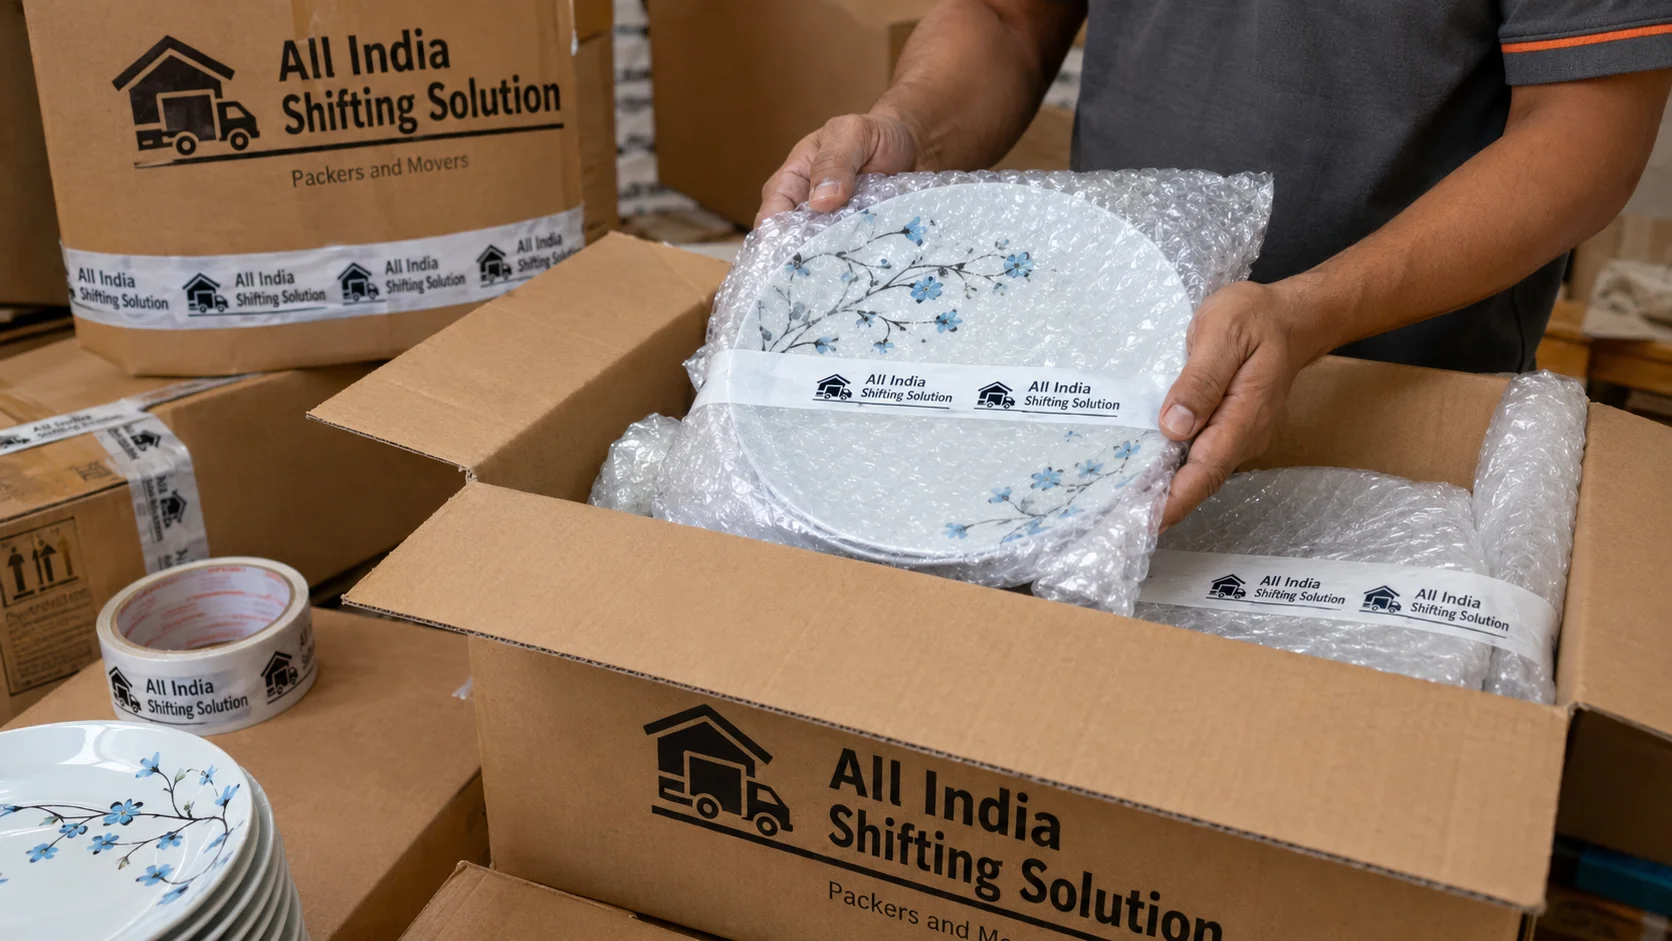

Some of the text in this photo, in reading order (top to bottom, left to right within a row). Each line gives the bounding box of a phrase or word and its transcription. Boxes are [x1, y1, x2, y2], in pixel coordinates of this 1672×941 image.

[279, 28, 450, 81] All India
[282, 75, 560, 135] Shifting Solution
[292, 155, 469, 187] Packers and Movers
[517, 231, 562, 253] All India
[385, 256, 439, 275] All India
[518, 255, 551, 272] Shifting
[78, 267, 136, 288] All India
[235, 270, 295, 288] All India
[386, 273, 466, 294] Shifting Solution
[80, 287, 169, 311] Shifting Solution
[236, 289, 326, 308] Shifting Solution
[865, 374, 926, 388] All India
[1028, 381, 1091, 394] All India
[860, 387, 953, 403] Shifting Solution
[1024, 395, 1120, 411] Shifting Solution
[1259, 575, 1321, 590] All India
[1254, 588, 1345, 605] Shifting Solution
[1414, 588, 1481, 609] All India
[1410, 602, 1509, 632] Shifting Solution
[146, 678, 214, 697] All India
[147, 695, 248, 719] Shifting Solution
[828, 748, 1061, 851] All India
[827, 804, 1224, 941] Shifting Solution
[828, 881, 919, 925] Packers
[927, 917, 969, 940] and
